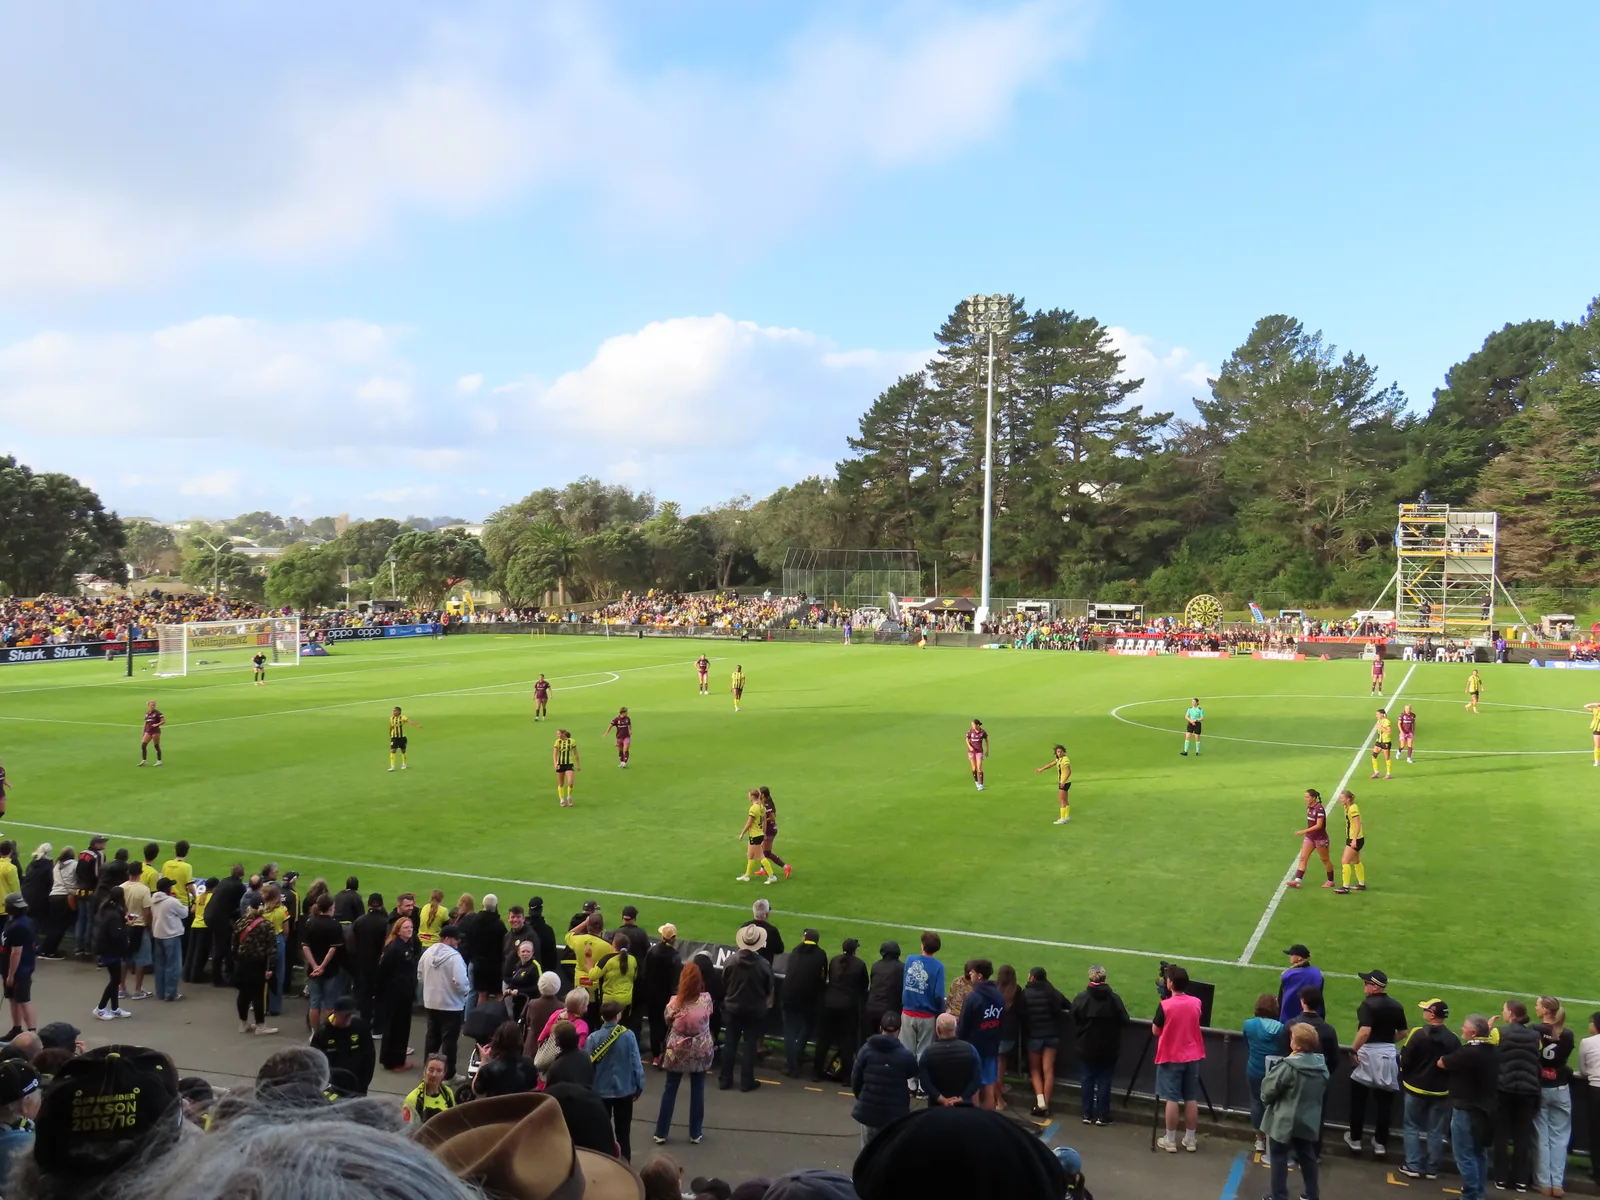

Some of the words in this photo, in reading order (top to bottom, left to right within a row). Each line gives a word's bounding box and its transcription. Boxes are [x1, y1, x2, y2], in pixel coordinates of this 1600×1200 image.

[358, 628, 381, 637] oppo
[983, 1004, 1003, 1019] sky
[1542, 1043, 1558, 1060] 6
[96, 1093, 136, 1103] MEMBER
[72, 1100, 137, 1117] SEASON
[71, 1113, 137, 1131] 2015/16
